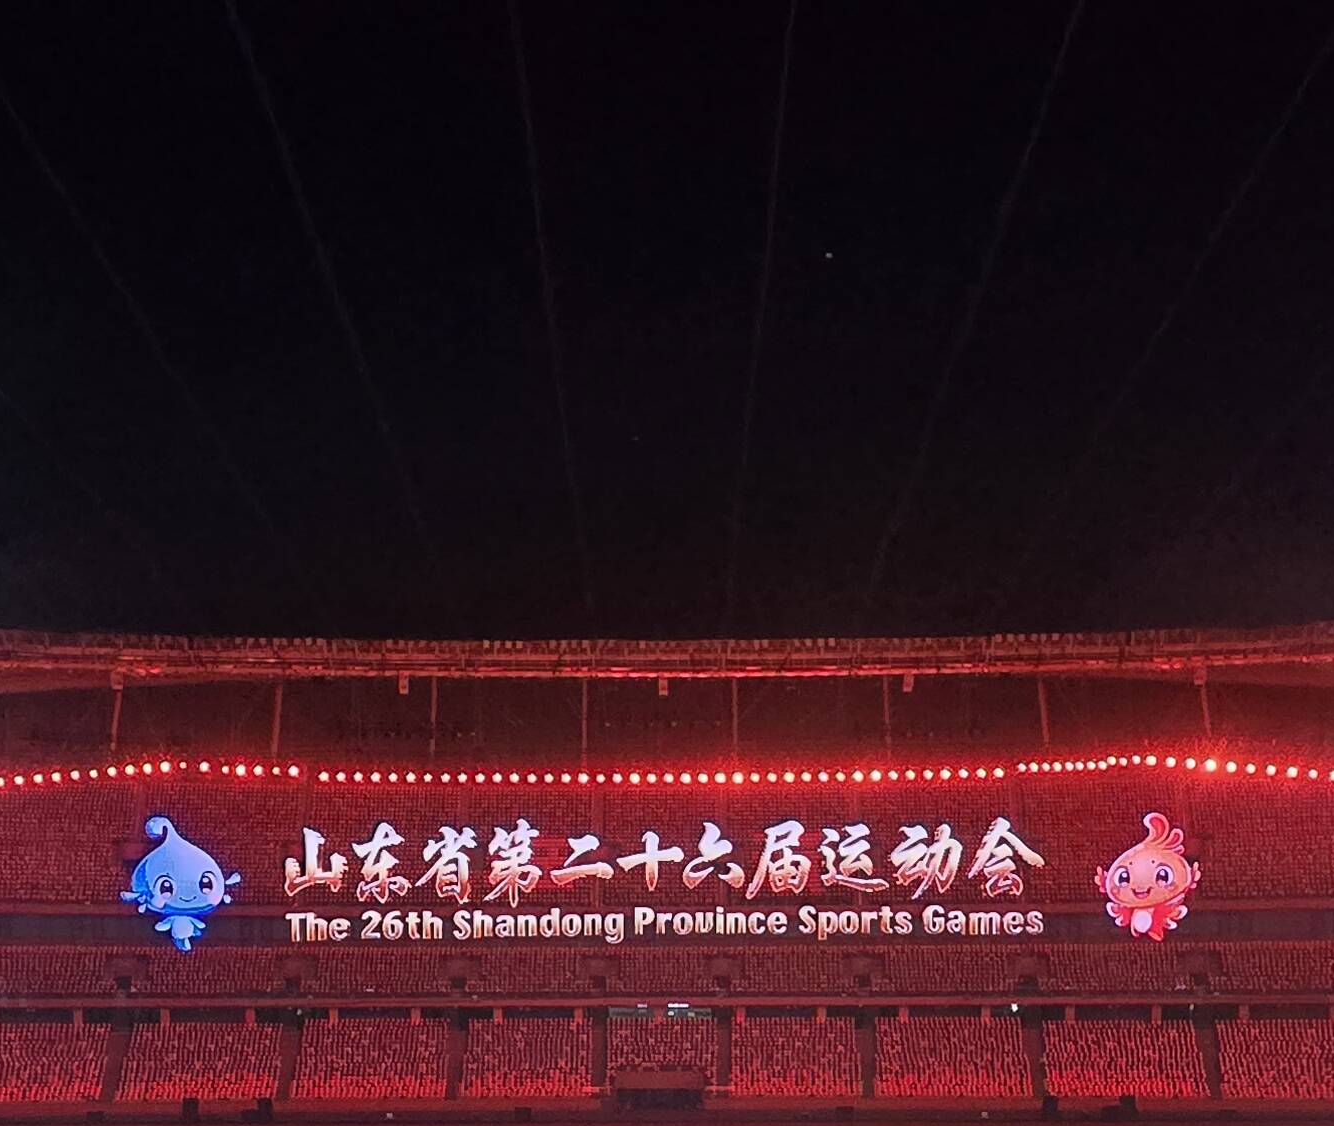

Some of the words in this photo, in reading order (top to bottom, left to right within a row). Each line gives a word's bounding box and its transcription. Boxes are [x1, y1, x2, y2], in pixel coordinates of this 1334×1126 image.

[285, 818, 1045, 906] 山东省第二十六届运动会
[286, 912, 349, 943] The
[360, 911, 444, 942] 26th
[452, 909, 625, 944] Shandong
[634, 907, 787, 936] Province
[798, 907, 913, 941] Sports
[923, 906, 1044, 936] Games
